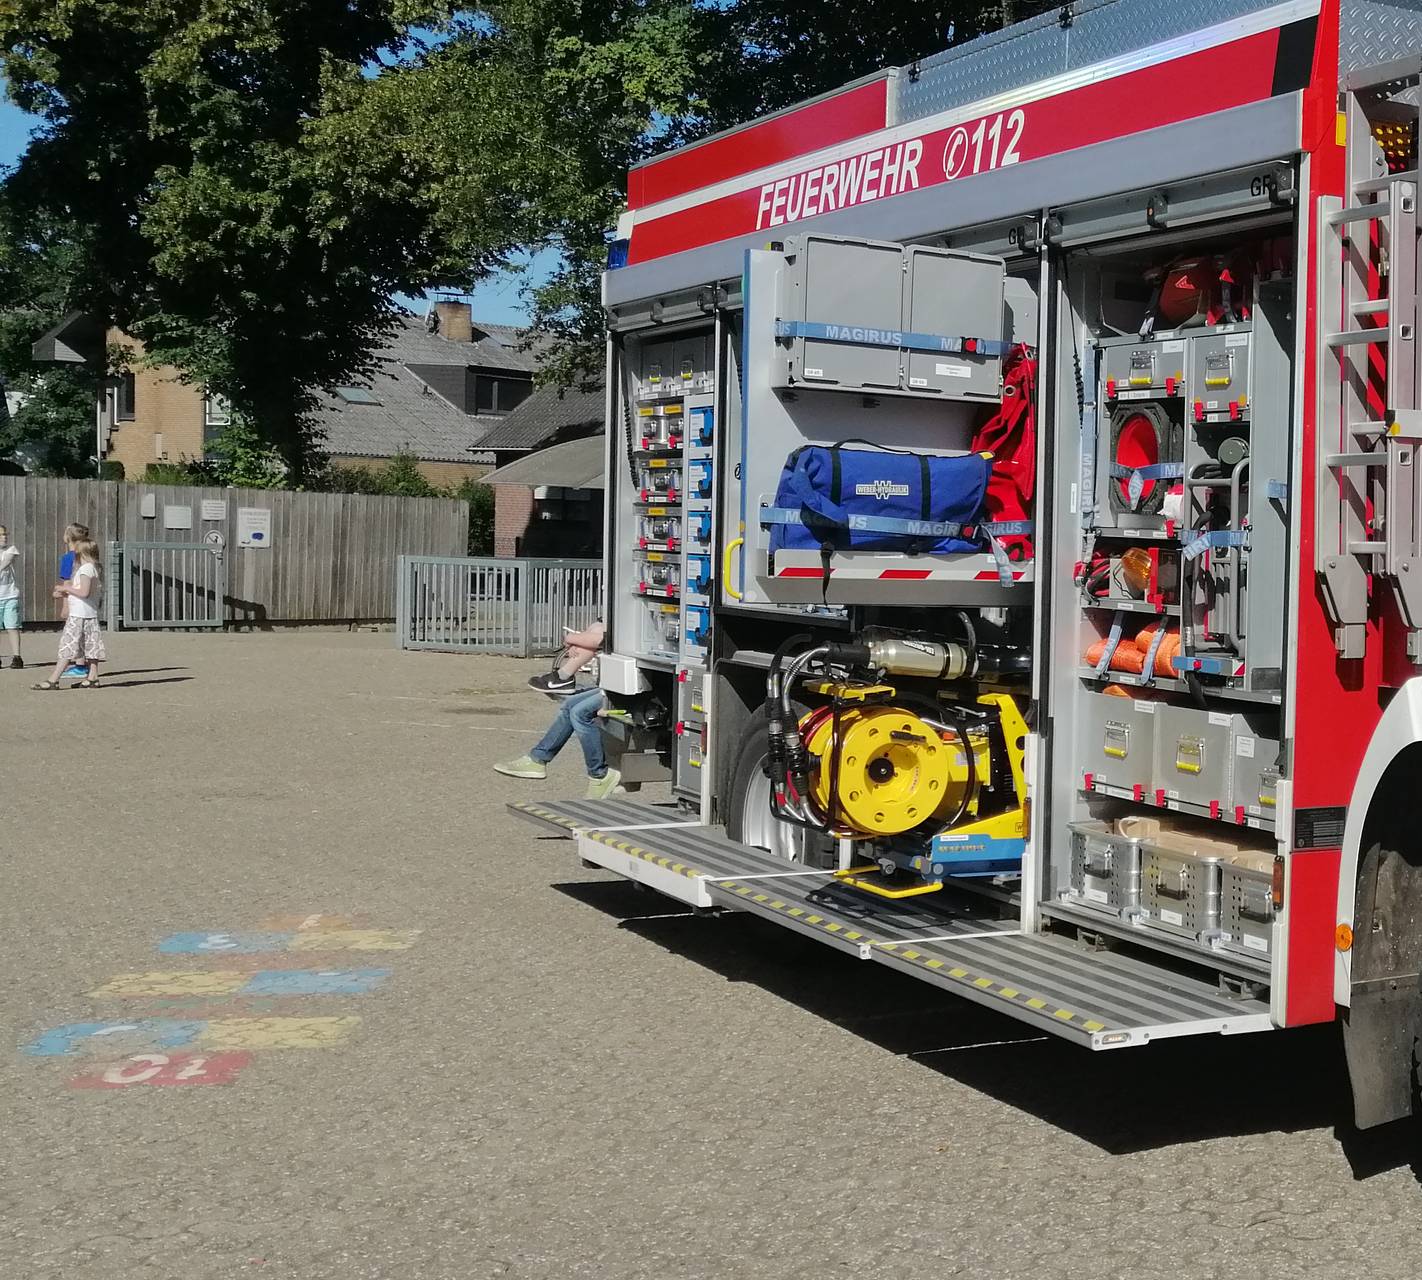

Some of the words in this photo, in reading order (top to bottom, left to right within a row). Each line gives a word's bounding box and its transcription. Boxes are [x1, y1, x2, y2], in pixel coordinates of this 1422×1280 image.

[756, 139, 923, 231] FEUERWEHR
[971, 109, 1025, 174] 112
[825, 325, 903, 345] MAGIRUS
